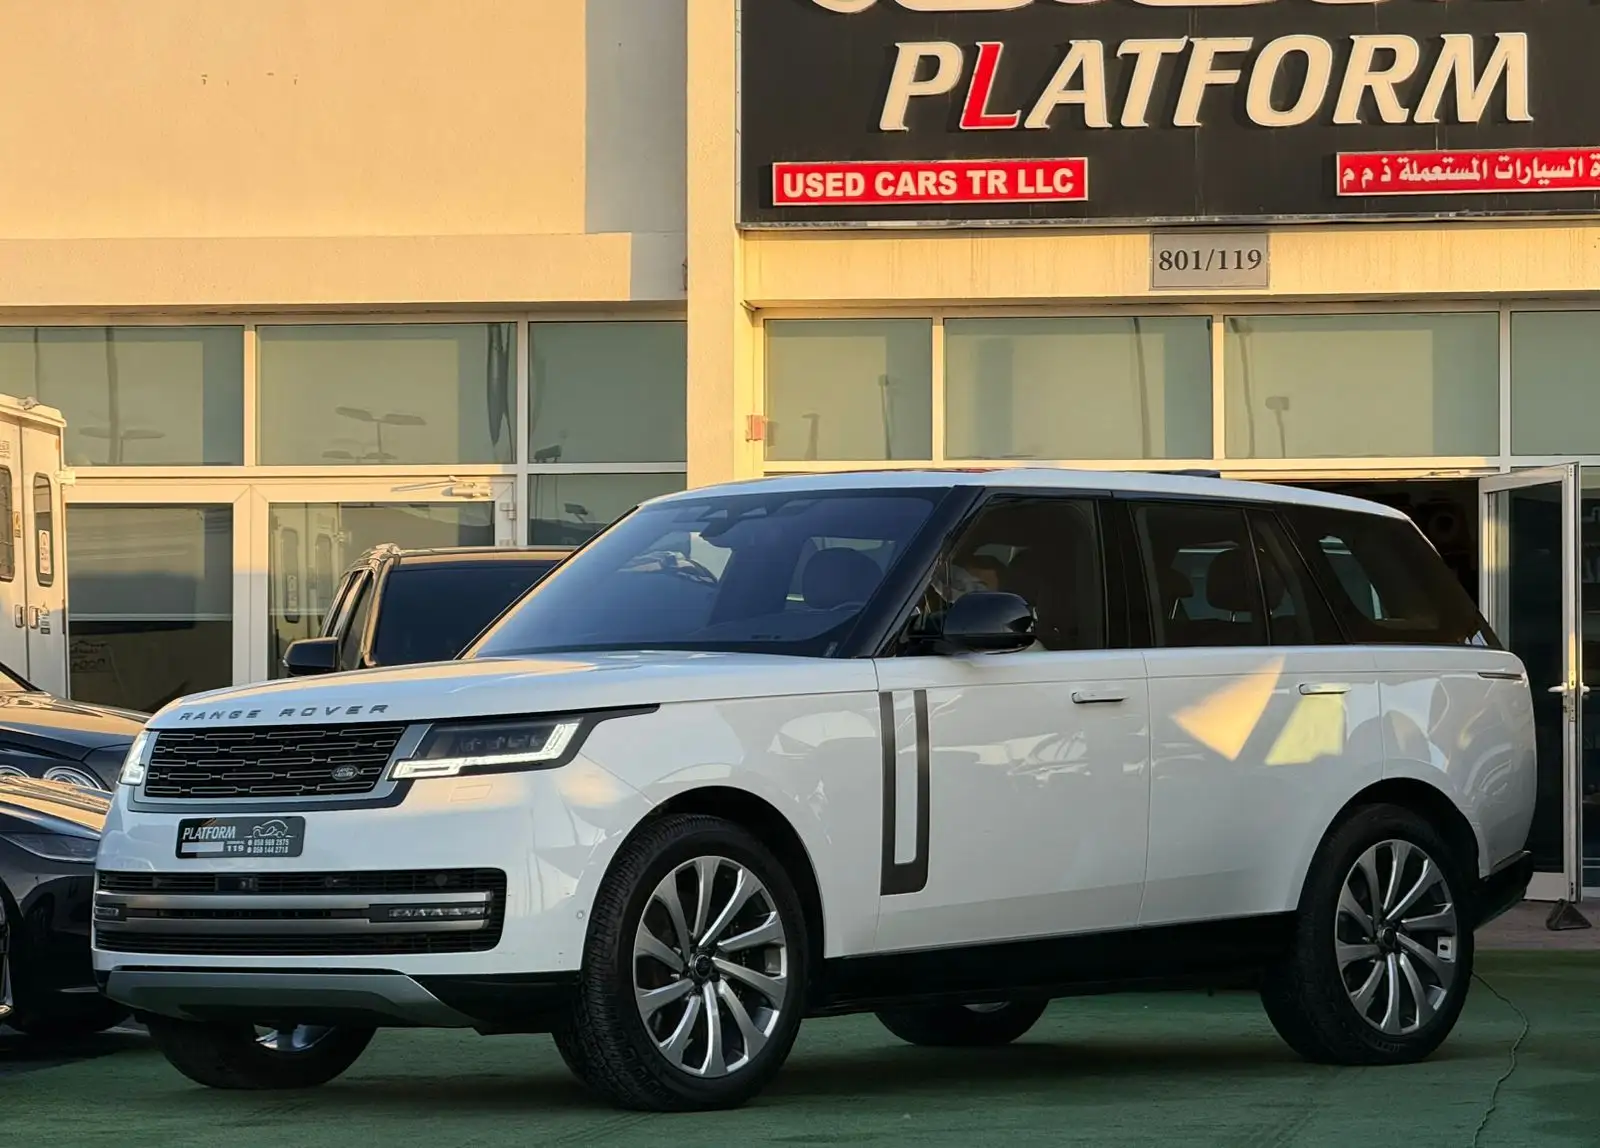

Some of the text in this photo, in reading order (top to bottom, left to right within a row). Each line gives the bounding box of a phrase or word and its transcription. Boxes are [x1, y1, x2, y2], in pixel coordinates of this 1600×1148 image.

[879, 32, 1534, 131] PLATFORM
[1342, 167, 1355, 189] م
[1360, 167, 1374, 189] م
[1380, 157, 1392, 182] ذ
[1397, 156, 1488, 182] المستعملة
[1495, 154, 1584, 185] السيارات
[783, 168, 1075, 198] USED CARS TR LLC
[1158, 249, 1262, 271] 801/119
[179, 704, 389, 721] RANGE ROVER
[182, 825, 237, 840] PLATFORM
[226, 844, 245, 852] 119
